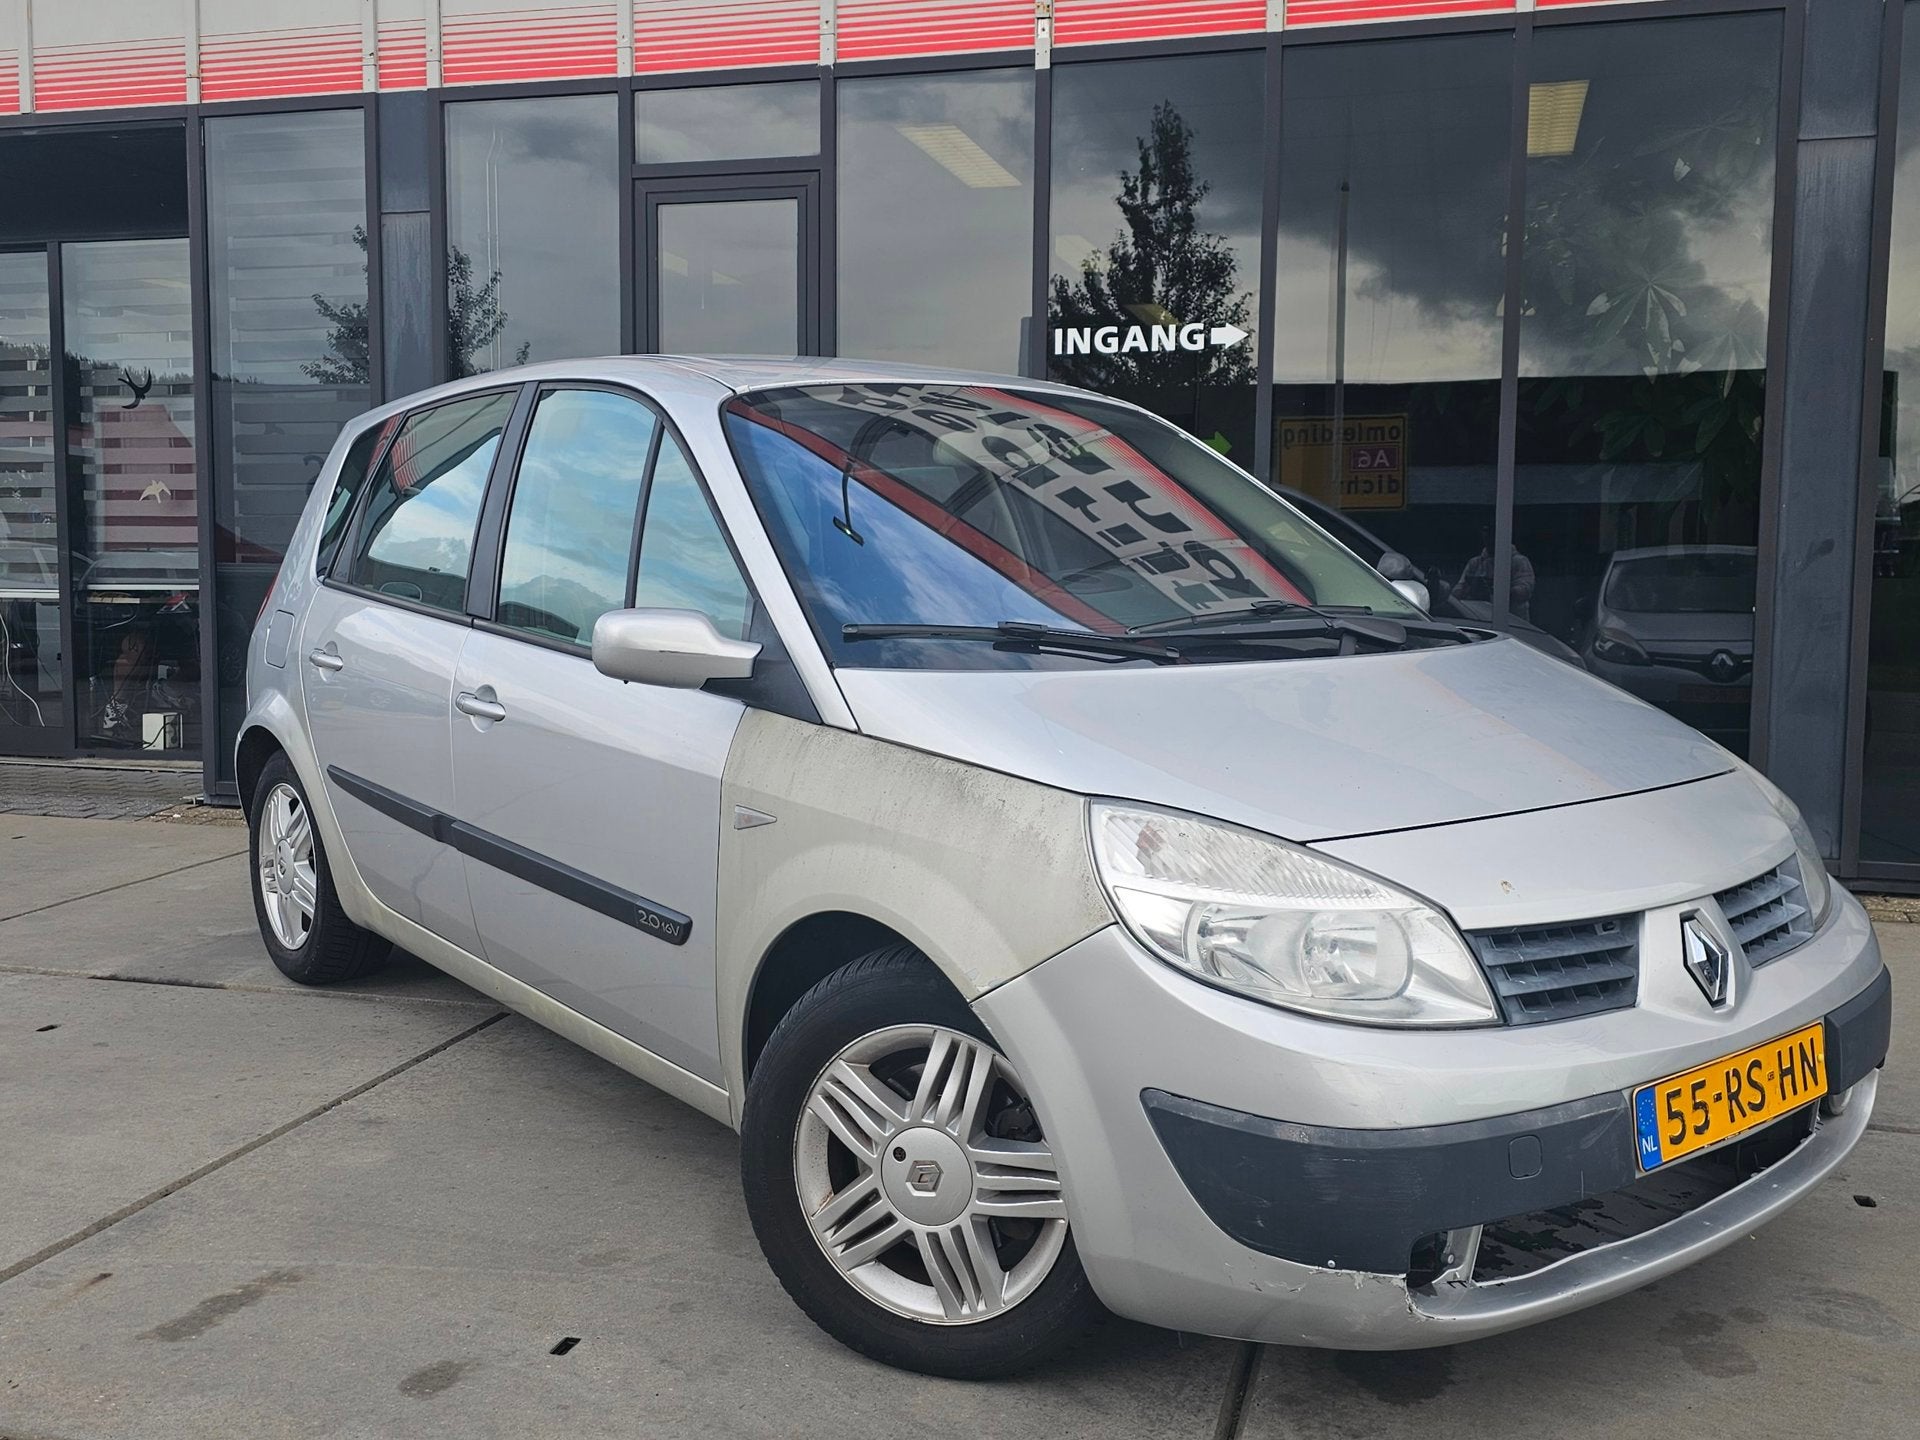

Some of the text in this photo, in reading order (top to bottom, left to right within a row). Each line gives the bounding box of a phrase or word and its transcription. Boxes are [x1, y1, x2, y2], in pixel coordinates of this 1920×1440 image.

[1054, 323, 1205, 355] INGANG
[661, 921, 680, 936] 16V
[1665, 1037, 1819, 1146] 55-RS-HN
[1641, 1136, 1658, 1155] NL
